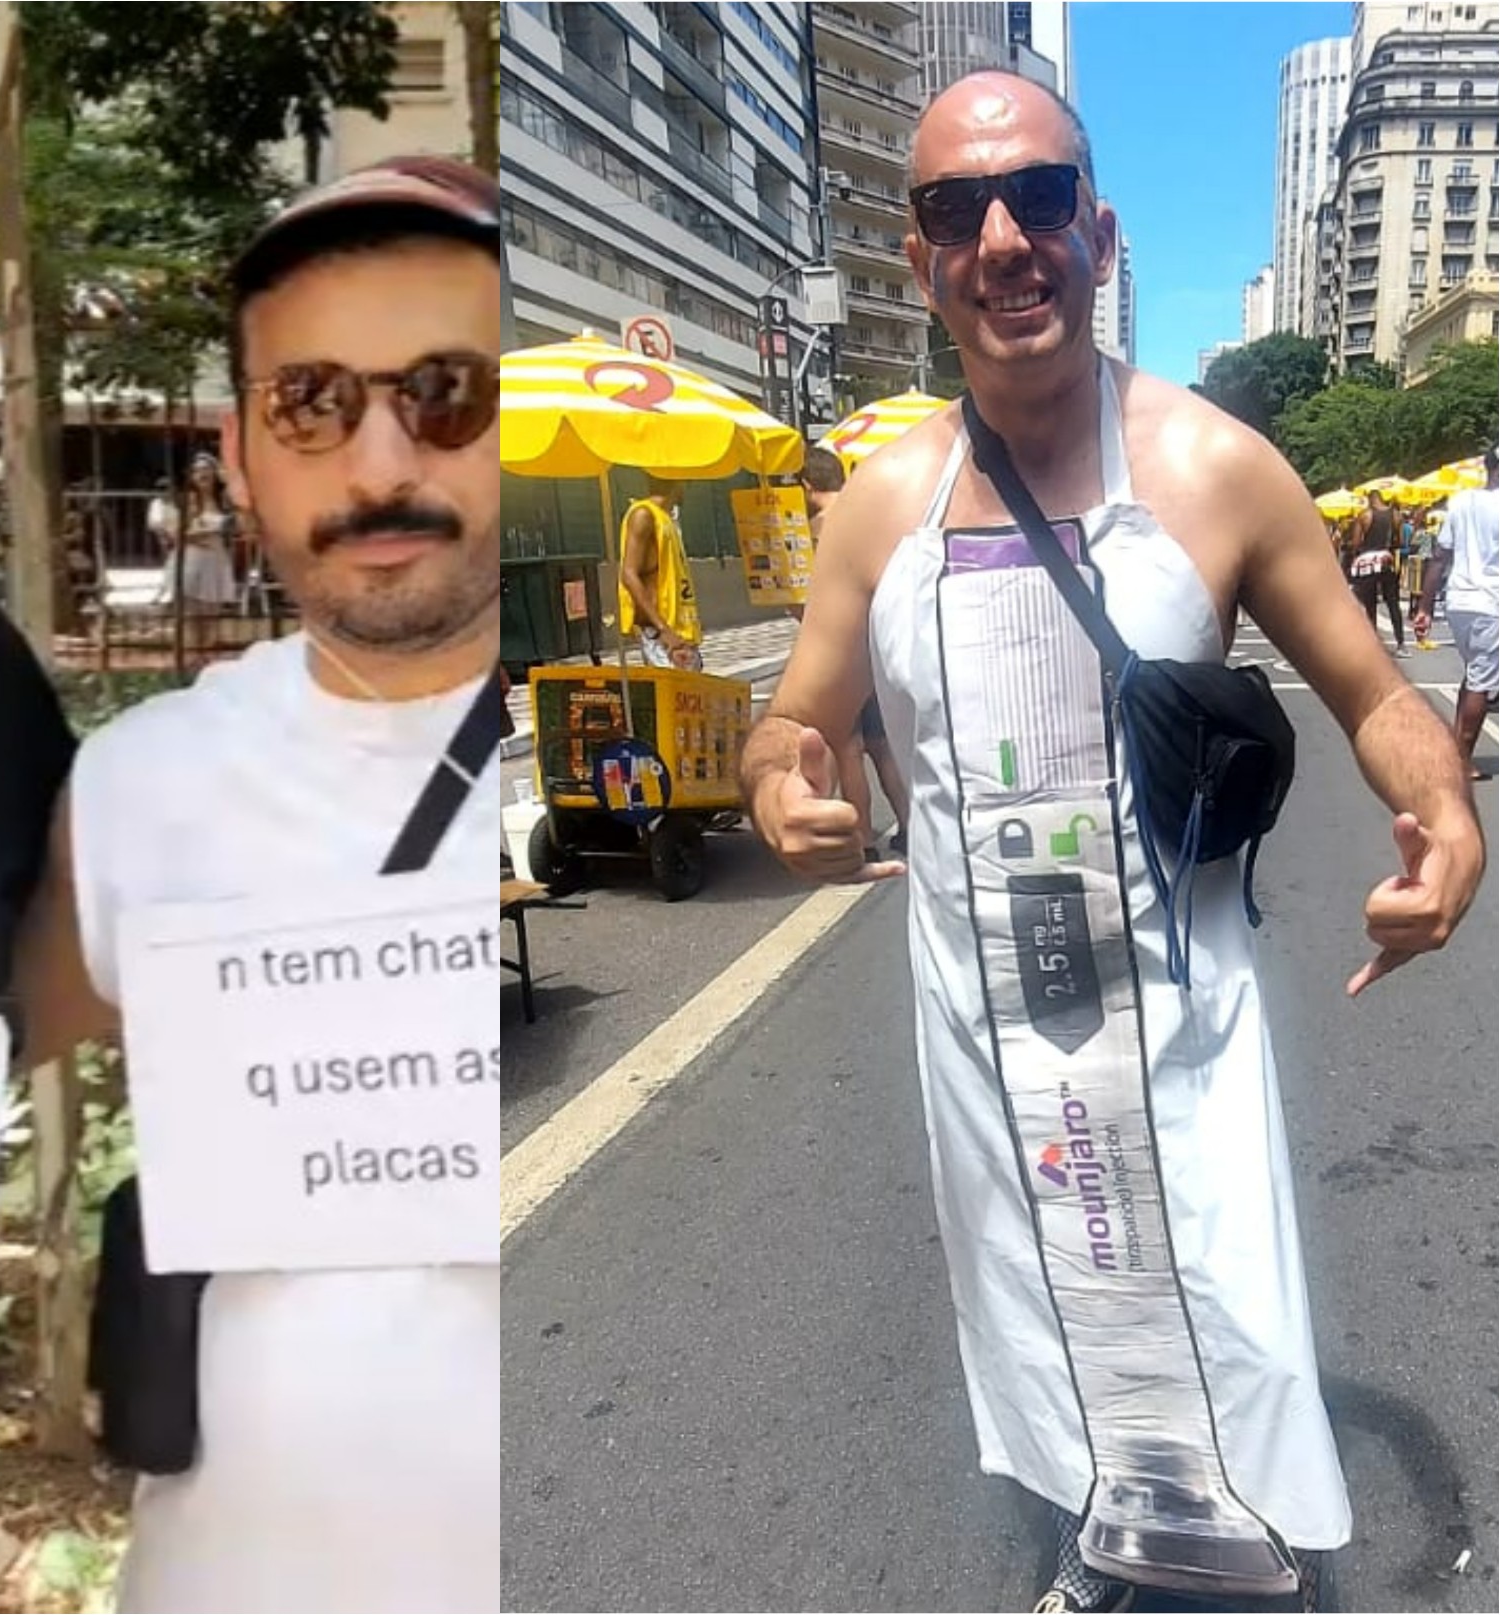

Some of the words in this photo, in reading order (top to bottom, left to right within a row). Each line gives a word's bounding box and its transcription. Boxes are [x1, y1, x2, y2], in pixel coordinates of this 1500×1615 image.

[219, 956, 247, 992] n
[260, 945, 361, 986] tem
[1037, 952, 1078, 999] 2.5
[247, 1063, 278, 1107] q
[292, 1052, 438, 1094] usem
[303, 1139, 480, 1196] placas
